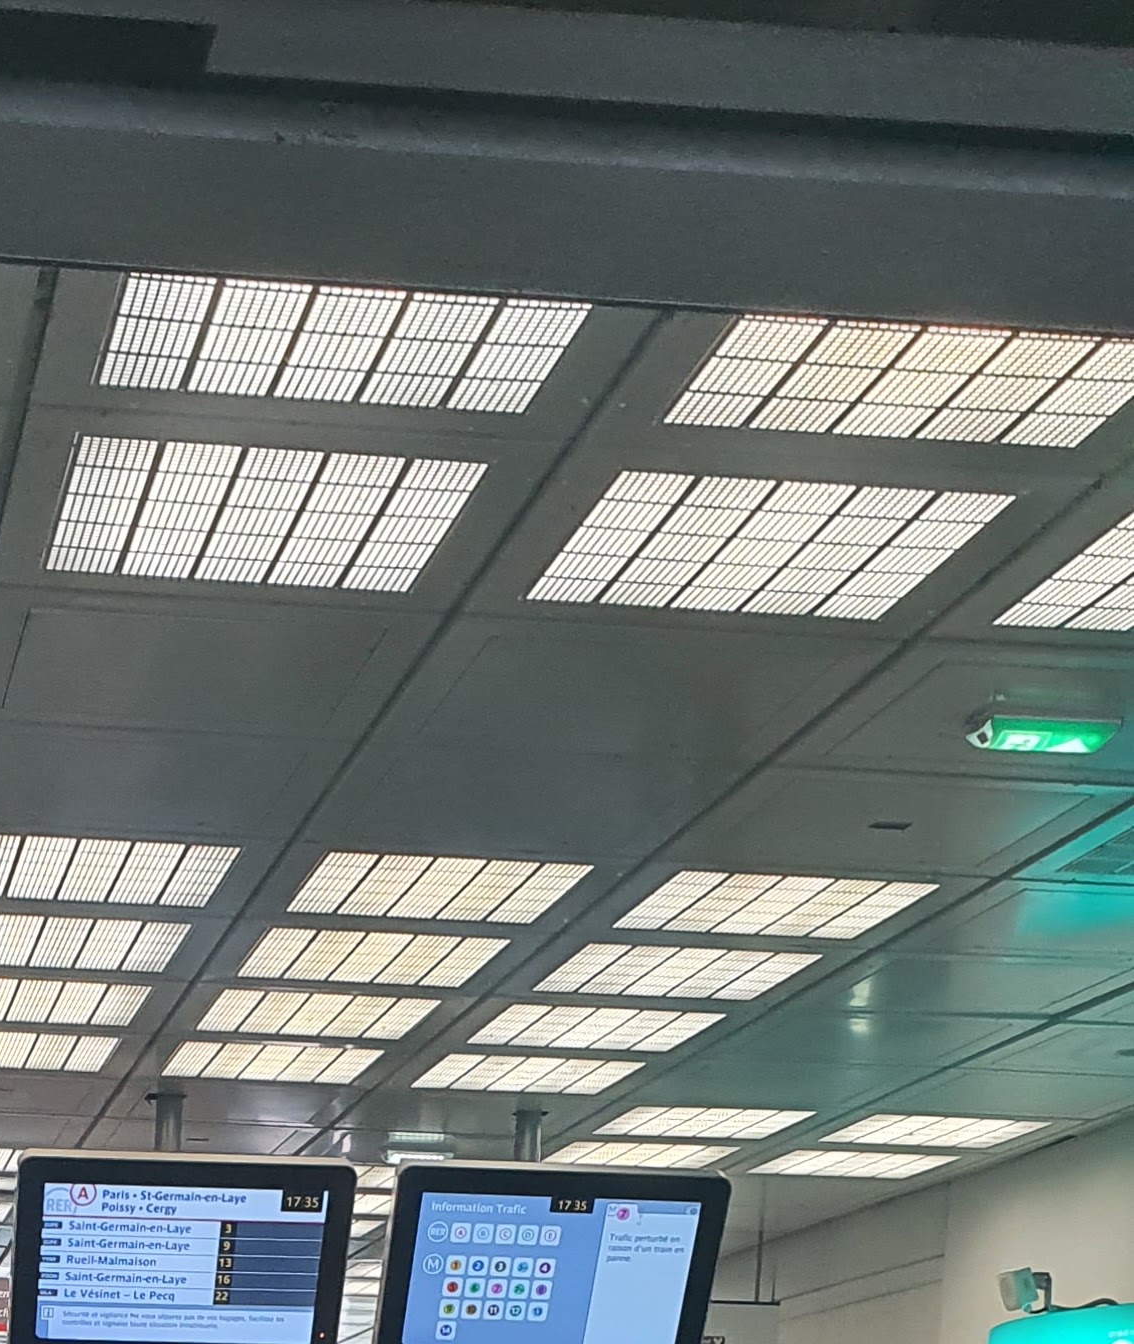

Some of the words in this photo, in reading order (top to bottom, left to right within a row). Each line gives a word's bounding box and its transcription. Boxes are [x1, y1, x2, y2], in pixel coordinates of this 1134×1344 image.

[46, 1199, 72, 1213] RER
[77, 1186, 89, 1200] A
[102, 1189, 130, 1200] Paris
[140, 1190, 247, 1205] St-Germain-en-Laye
[286, 1196, 319, 1209] 1735
[102, 1202, 136, 1215] Poissy
[146, 1203, 177, 1216] Cergy
[431, 1201, 493, 1214] Information
[496, 1203, 527, 1215] Trafic
[69, 1220, 192, 1235] Saint-Germain-en-Laye
[225, 1223, 232, 1234] 3
[610, 1233, 633, 1242] Trafic
[67, 1238, 190, 1252] Saint-Germain-en-Laye
[223, 1241, 231, 1251] 9
[66, 1255, 157, 1267] Rueil-Malmaison
[219, 1258, 232, 1268] 13
[427, 1258, 440, 1267] M
[65, 1271, 187, 1286] Saint-Germain-en-Laye
[217, 1275, 231, 1285] 16
[64, 1288, 77, 1298] Le
[80, 1288, 121, 1299] Vésinet
[133, 1290, 146, 1300] Le
[149, 1291, 175, 1302] Pecq
[215, 1291, 229, 1301] 22
